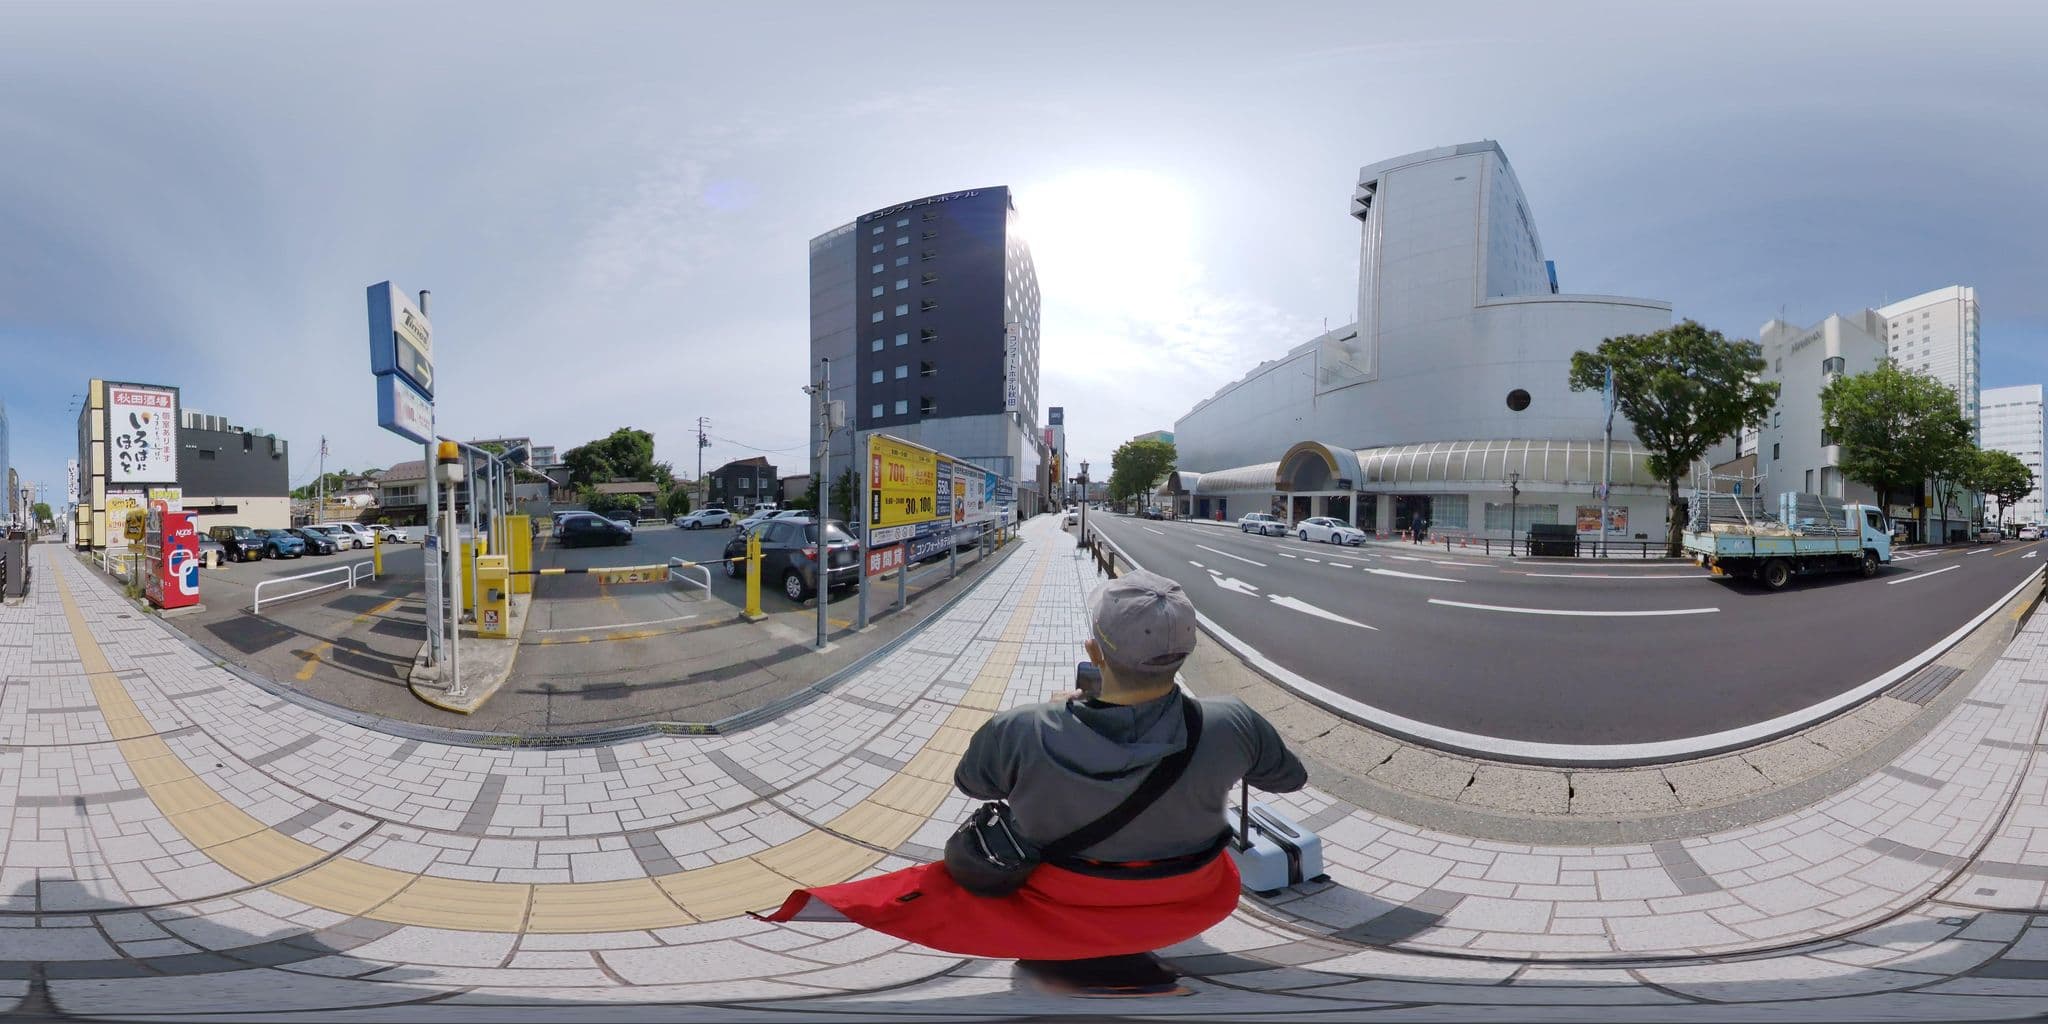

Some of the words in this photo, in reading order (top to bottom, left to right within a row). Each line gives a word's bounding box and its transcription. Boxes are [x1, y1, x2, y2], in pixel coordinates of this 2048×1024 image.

[117, 393, 169, 407] 秋田酒場
[906, 498, 916, 514] 30
[870, 548, 903, 571] 時間貸
